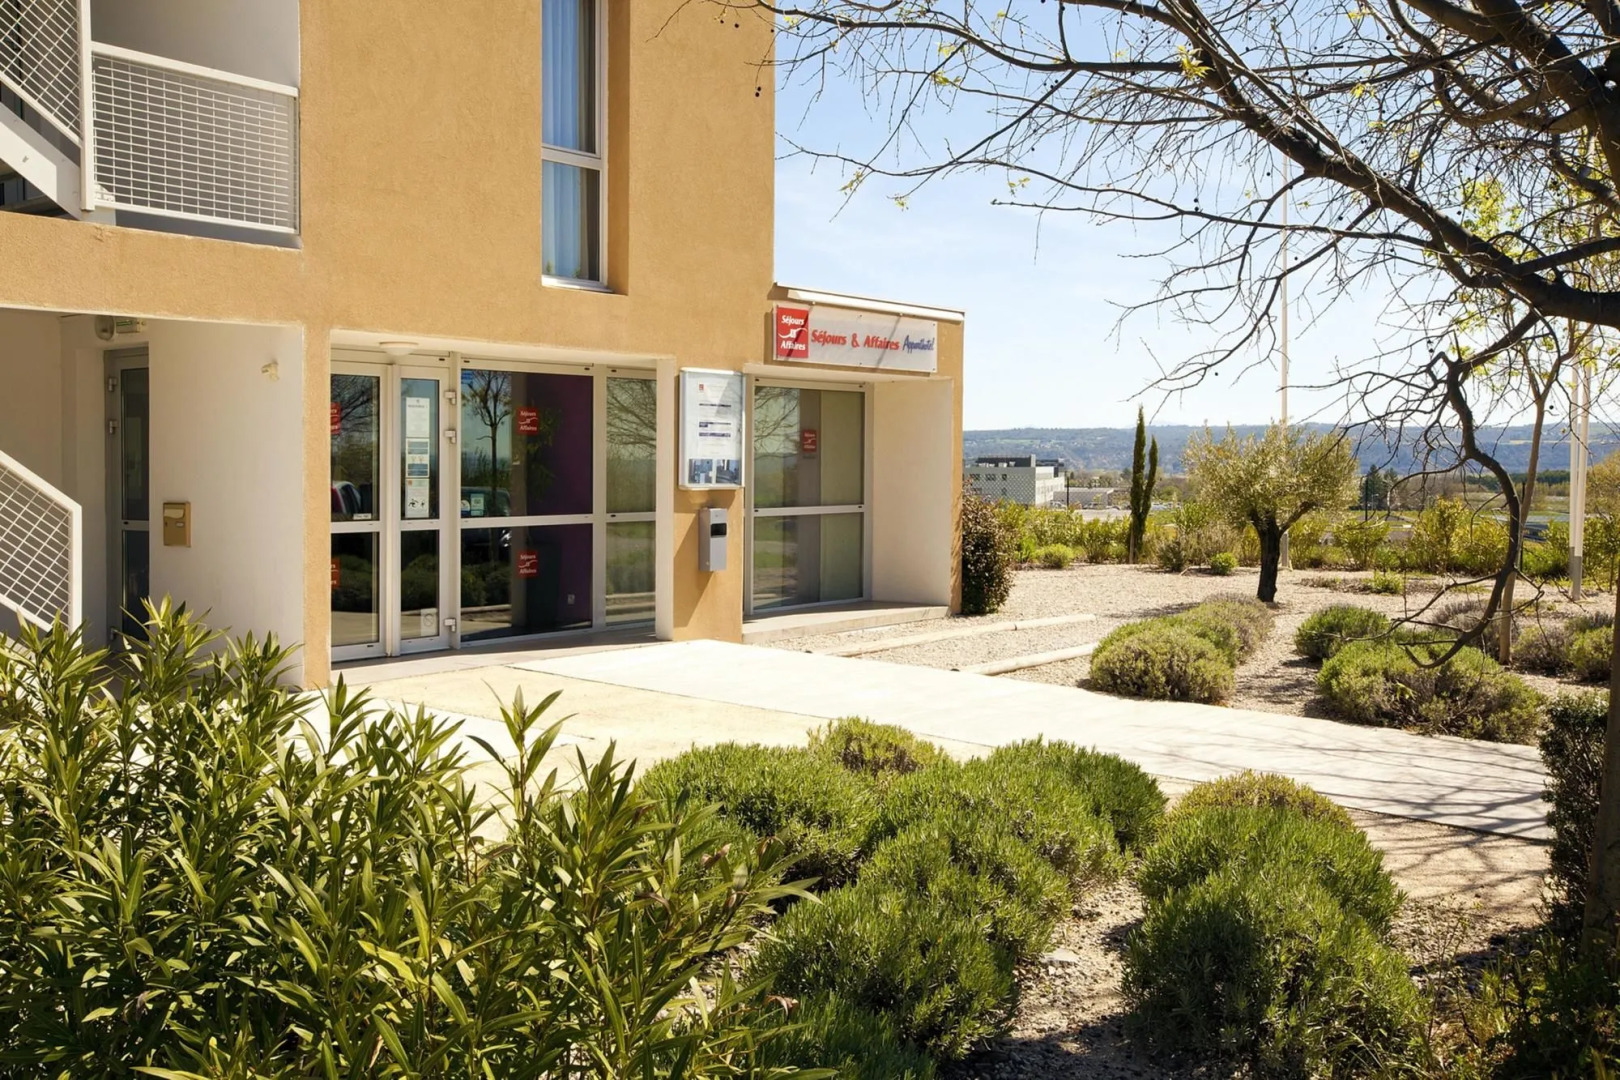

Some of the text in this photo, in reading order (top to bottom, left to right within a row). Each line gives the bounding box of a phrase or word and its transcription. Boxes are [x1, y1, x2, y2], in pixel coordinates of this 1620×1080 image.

[781, 314, 805, 326] Séjours
[780, 340, 806, 351] Affaires
[811, 329, 847, 346] Séjours
[851, 333, 860, 348] &
[863, 335, 900, 350] Affaires
